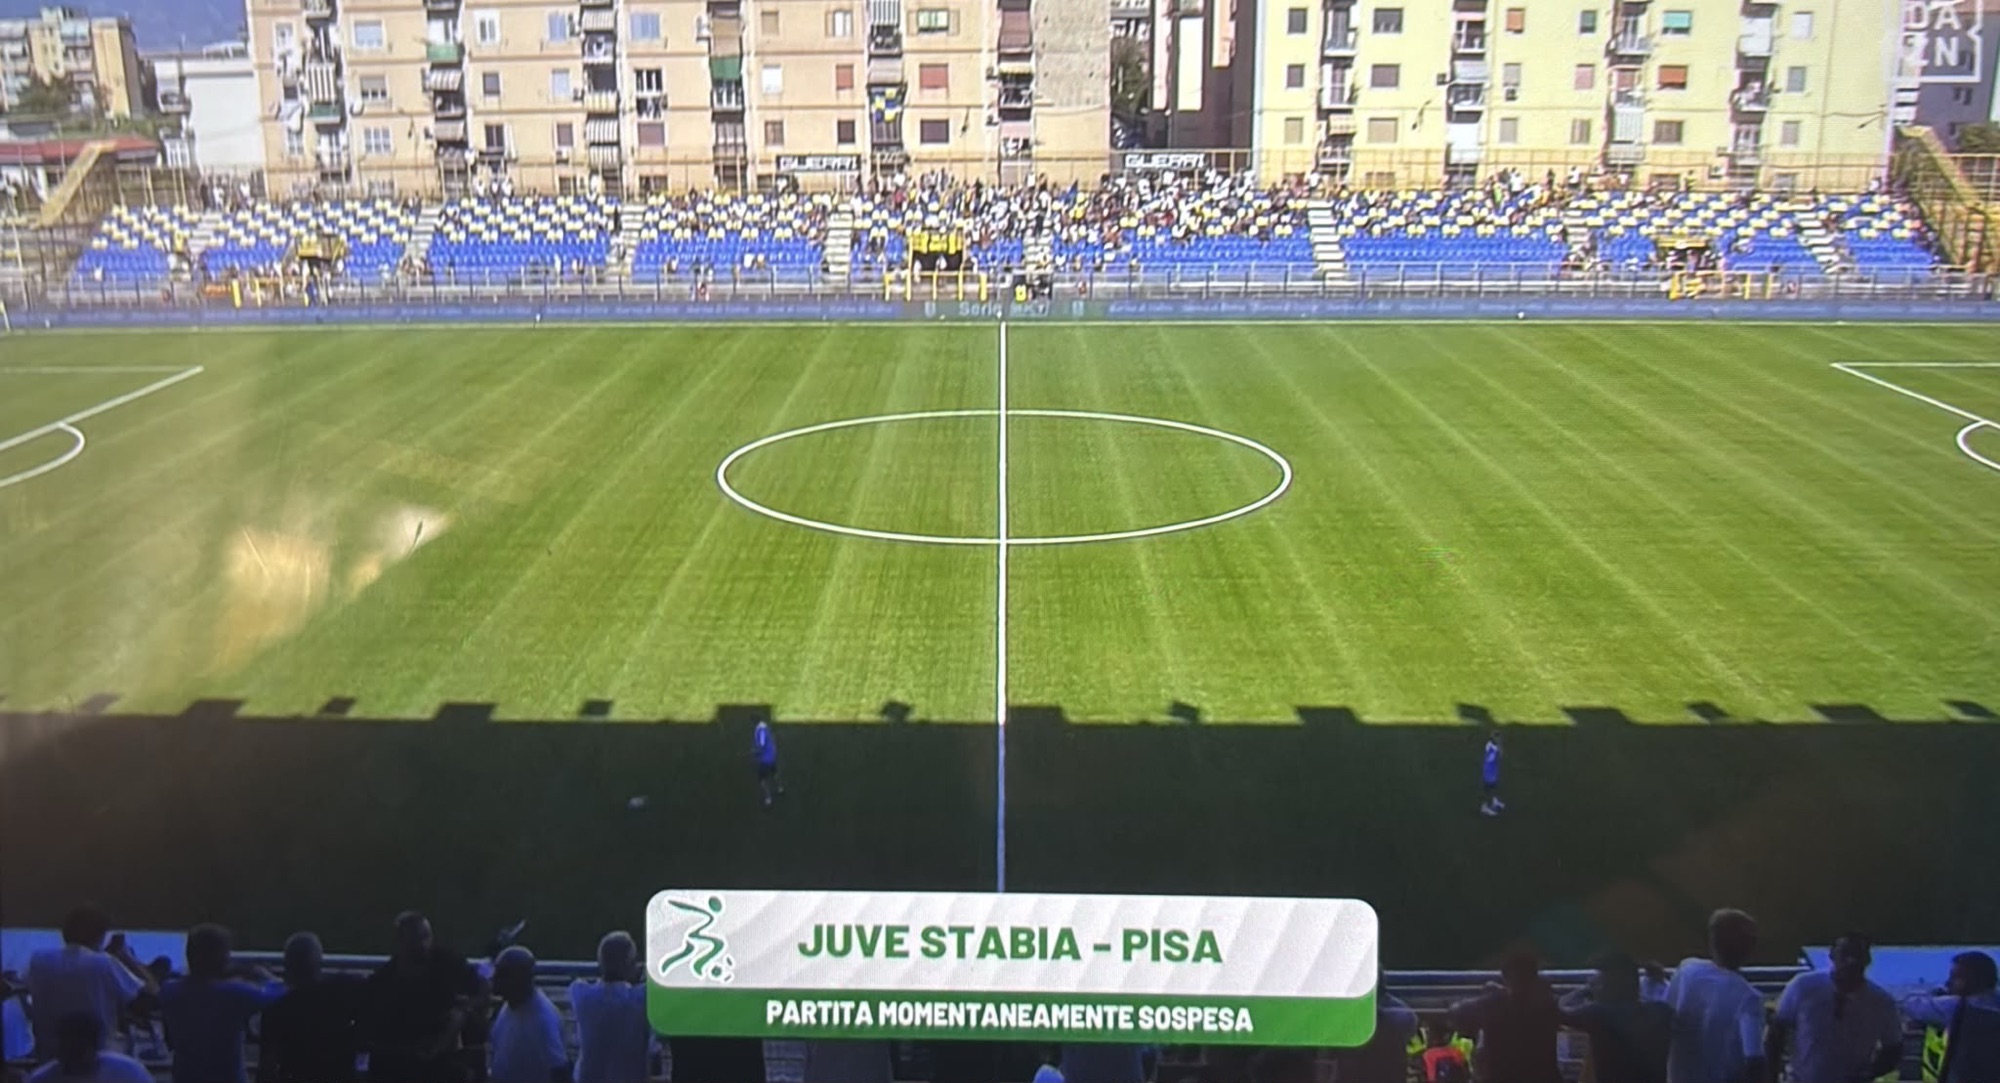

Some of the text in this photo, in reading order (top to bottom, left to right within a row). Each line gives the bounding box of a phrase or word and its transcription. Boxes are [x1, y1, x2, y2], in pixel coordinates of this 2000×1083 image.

[1906, 4, 1961, 30] DA
[1905, 35, 1960, 67] ZN
[798, 925, 907, 958] JUVE
[921, 926, 1081, 961] STABIA
[1123, 929, 1221, 963] PISA
[766, 999, 1254, 1032] PARTITA MOMENTANEAMENTE SOSPESA
